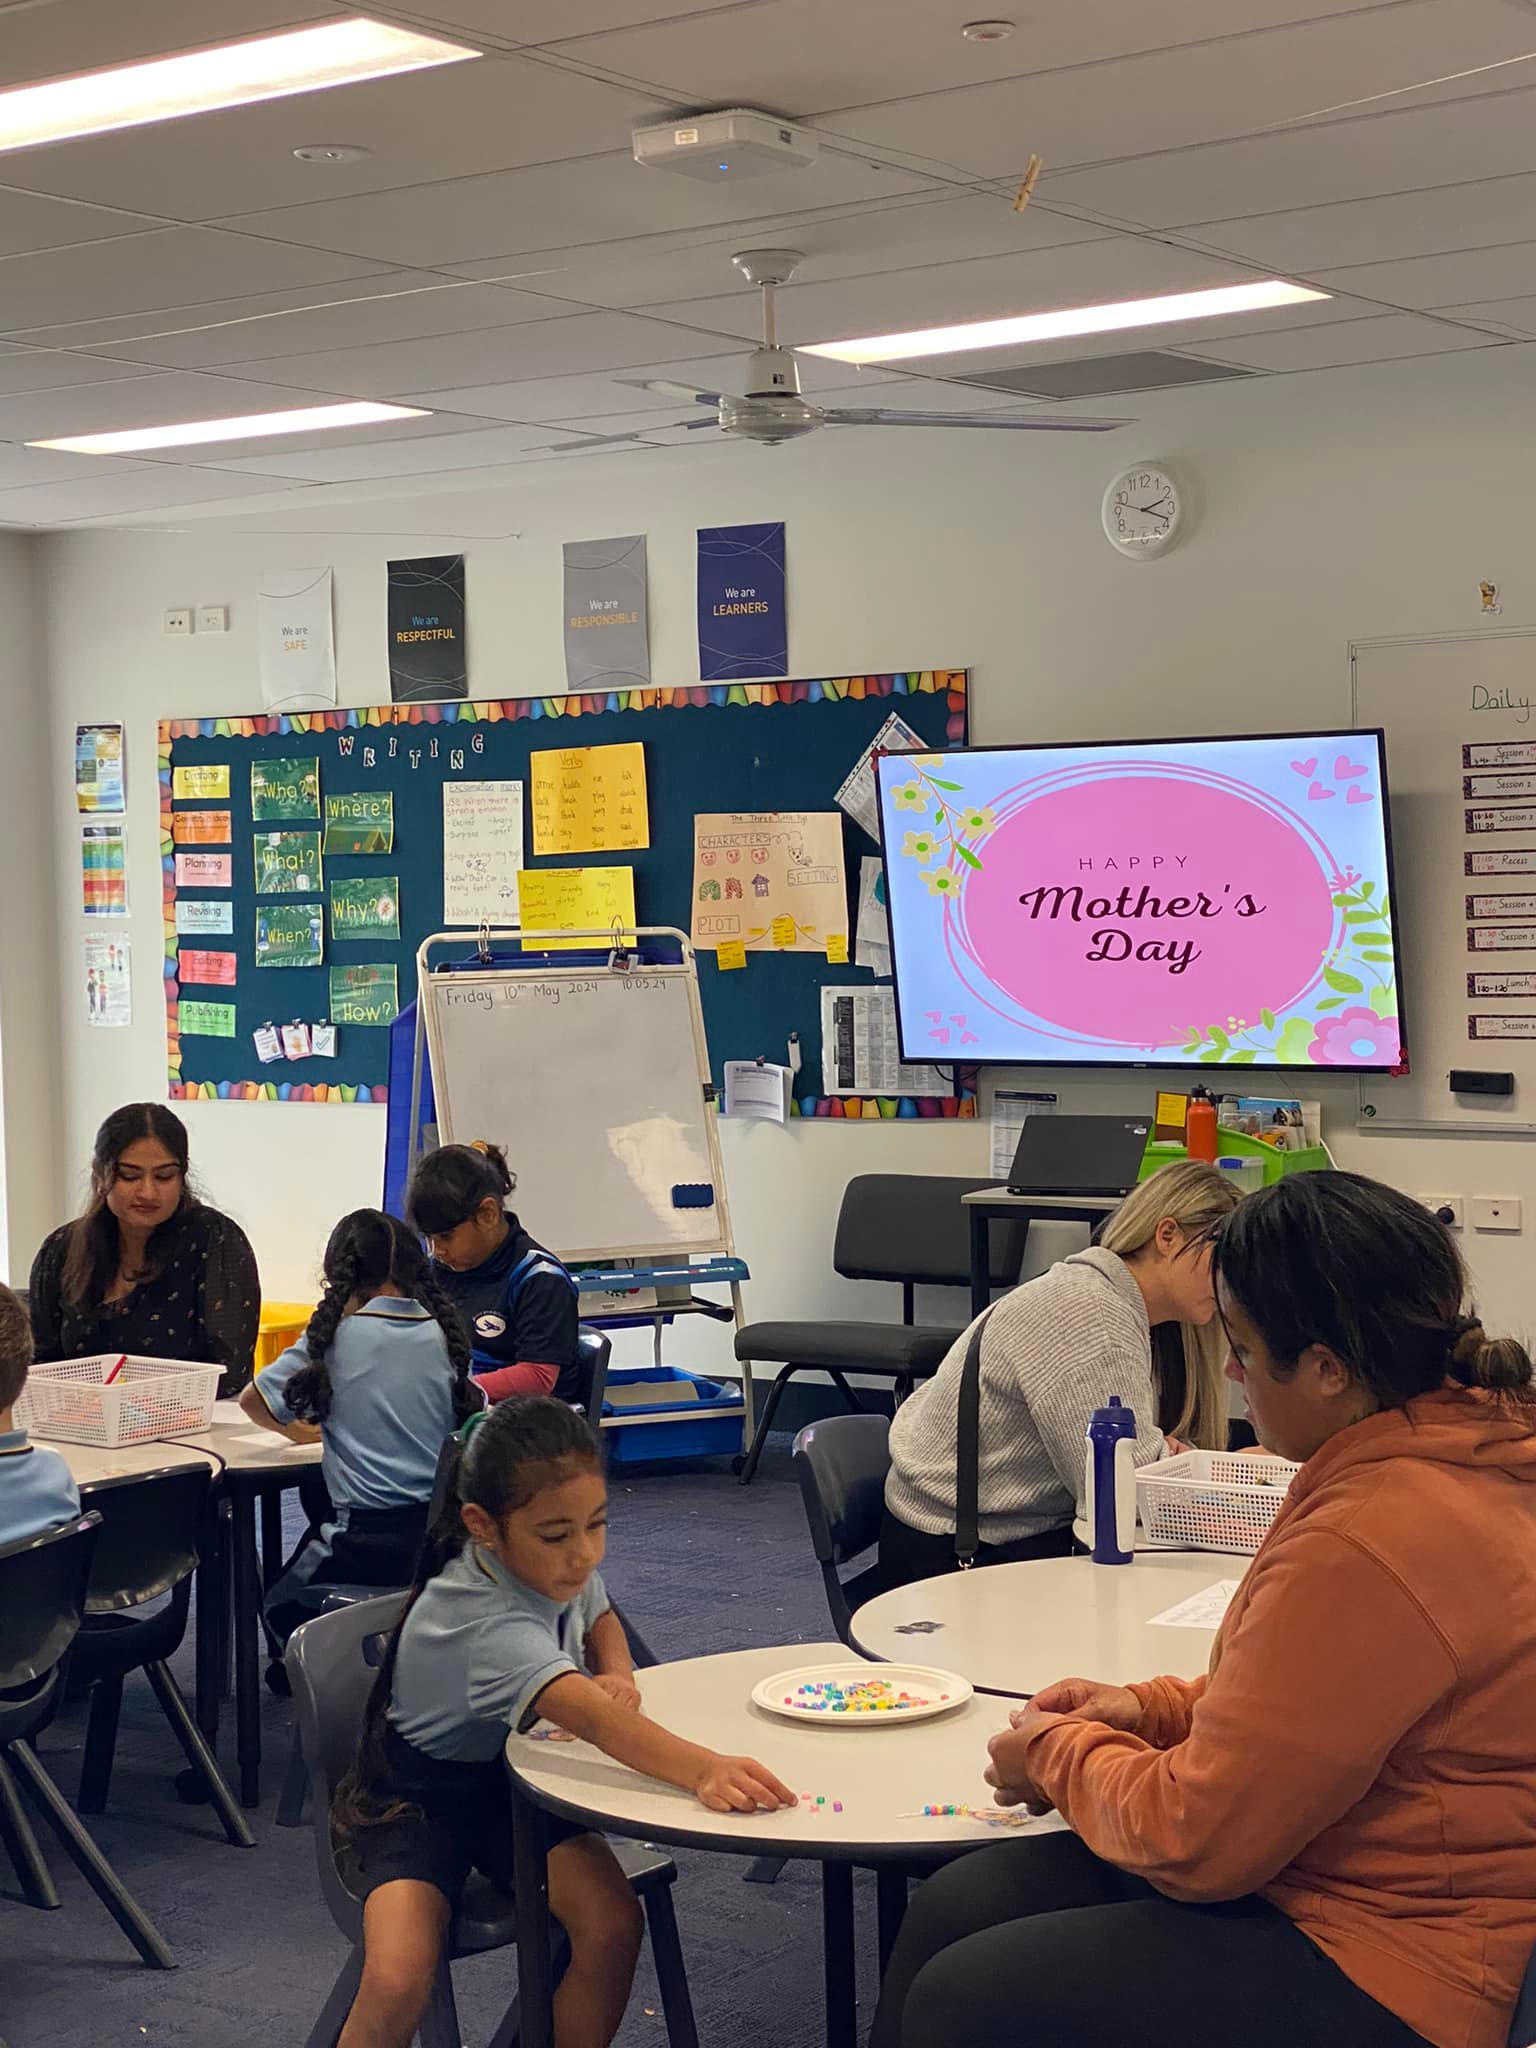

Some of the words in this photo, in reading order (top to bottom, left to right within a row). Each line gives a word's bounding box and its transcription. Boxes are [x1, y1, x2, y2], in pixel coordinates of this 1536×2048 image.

[1128, 478, 1137, 491] 11
[1140, 474, 1151, 488] 12
[1155, 478, 1160, 490] 1
[1115, 490, 1129, 505] 10
[1163, 485, 1171, 499] 2
[1167, 500, 1176, 515] 3
[1118, 518, 1126, 533] 8
[1162, 518, 1170, 529] 4
[724, 587, 739, 599] We
[740, 588, 756, 598] are
[589, 600, 603, 610] We
[604, 599, 619, 609] are
[712, 601, 769, 617] LEARNERS
[411, 615, 425, 626] We
[425, 616, 440, 626] are
[570, 611, 639, 629] RESPONSIBLE
[281, 626, 293, 636] We
[294, 626, 308, 635] are
[396, 628, 456, 644] RESPECTFUL
[283, 640, 308, 651] SAFE
[1472, 684, 1531, 724] Daily
[1496, 747, 1524, 759] Session
[265, 780, 307, 799] Who?
[1496, 777, 1524, 789] Session
[329, 799, 390, 818] Where?
[1499, 811, 1527, 823] Session
[700, 835, 770, 847] CHARACTERS
[262, 849, 315, 870] What?
[1078, 855, 1188, 871] HAPPY
[1501, 854, 1529, 866] Recess
[788, 868, 838, 884] SETTING
[1018, 883, 1267, 922] Mother's
[1499, 898, 1527, 909] Session
[187, 904, 222, 917] Revising
[332, 898, 377, 922] Why?
[699, 917, 734, 932] PLOT
[267, 927, 312, 944] When?
[1501, 930, 1528, 941] Session
[1085, 928, 1203, 975] Day
[1506, 976, 1530, 987] Lunch
[446, 988, 493, 1010] Friday
[534, 982, 560, 1004] May
[568, 981, 598, 994] 2024
[185, 1004, 229, 1019] Publishing
[343, 1001, 391, 1022] How?
[1502, 1019, 1529, 1030] Session
